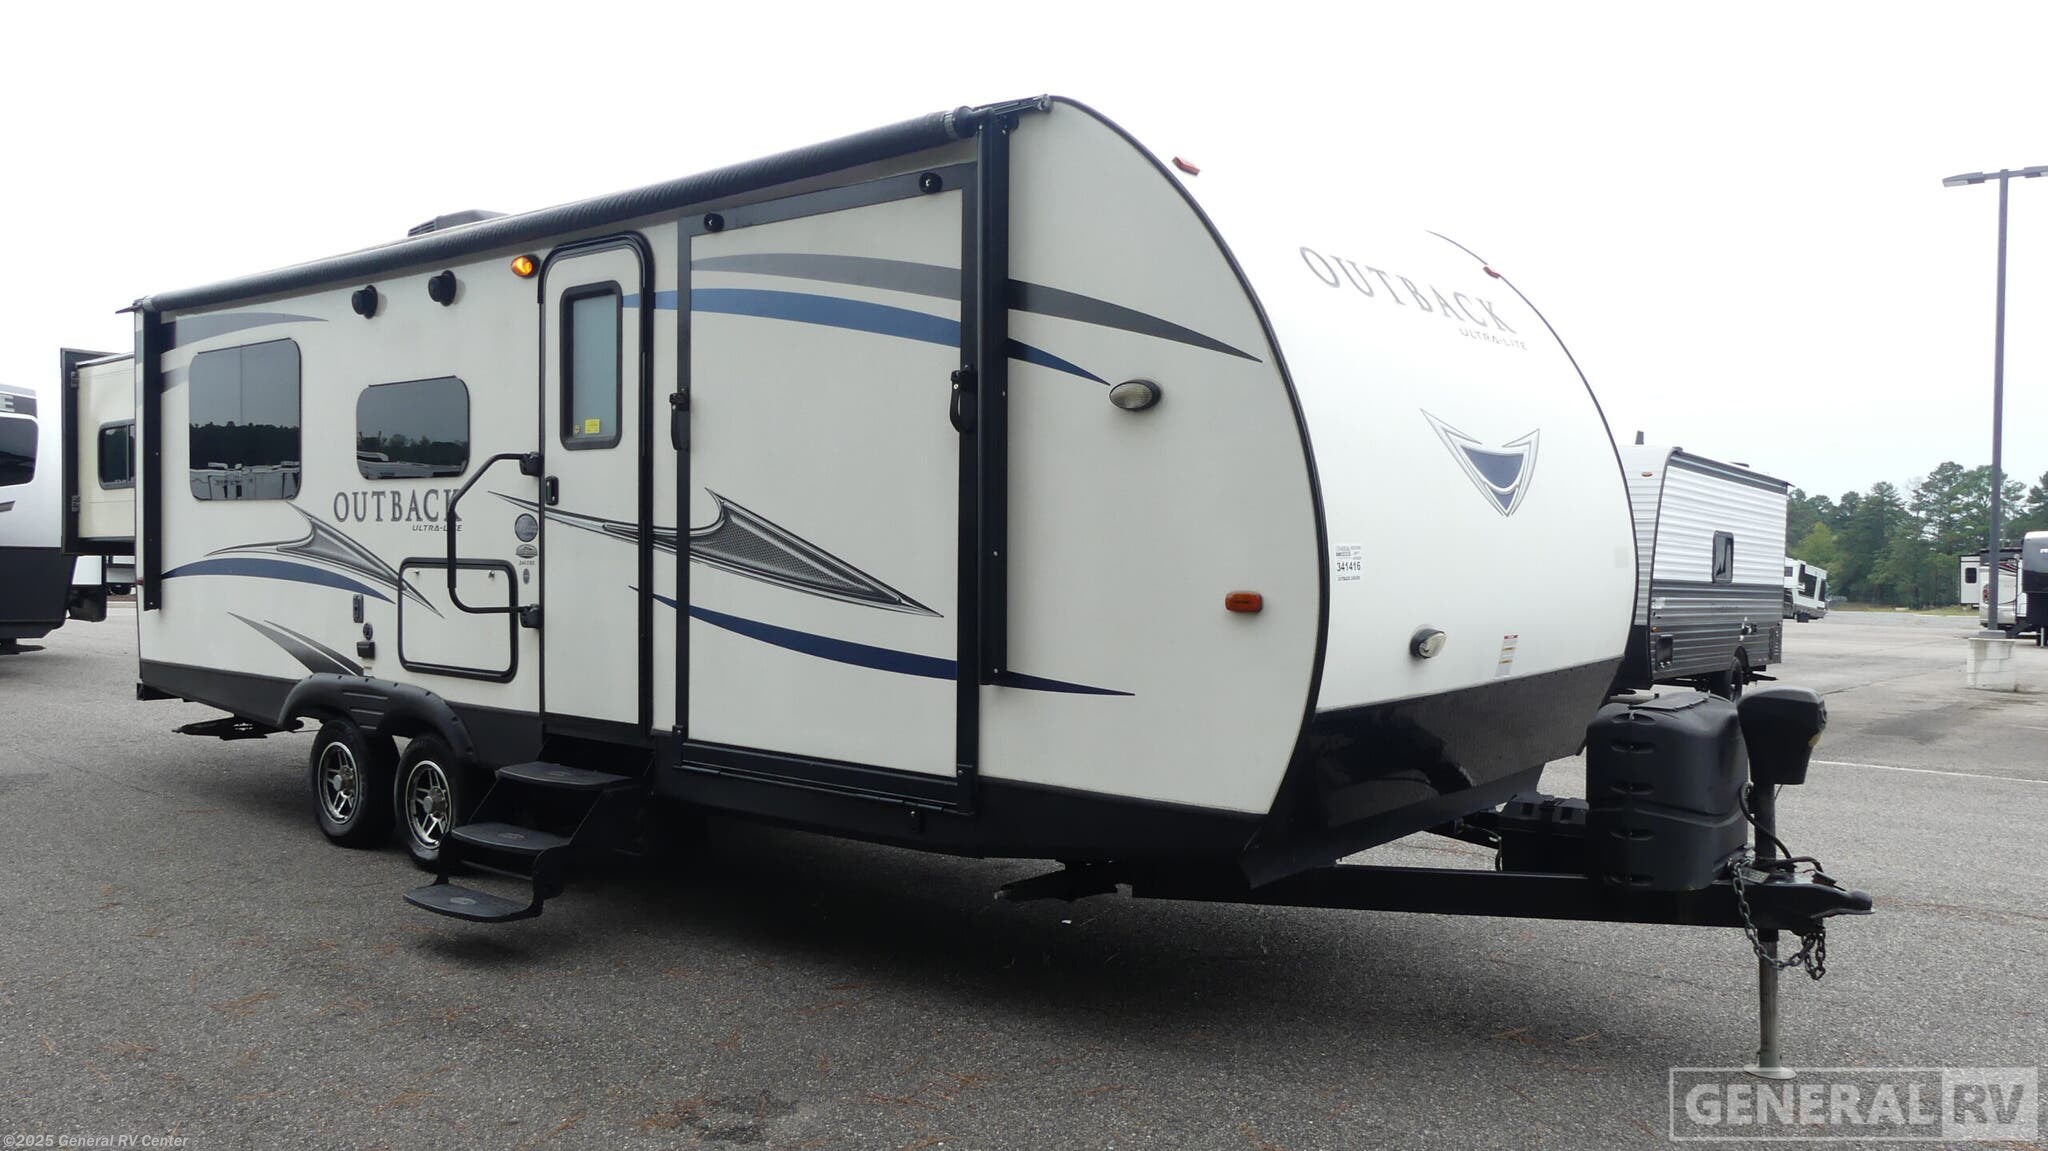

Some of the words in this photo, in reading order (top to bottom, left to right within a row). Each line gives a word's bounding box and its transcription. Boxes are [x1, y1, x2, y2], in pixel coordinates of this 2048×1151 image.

[1299, 245, 1517, 335] OUTBACK
[333, 488, 463, 523] OUTBACK
[412, 524, 463, 532] ULTRA-LE
[1336, 561, 1361, 572] 341416
